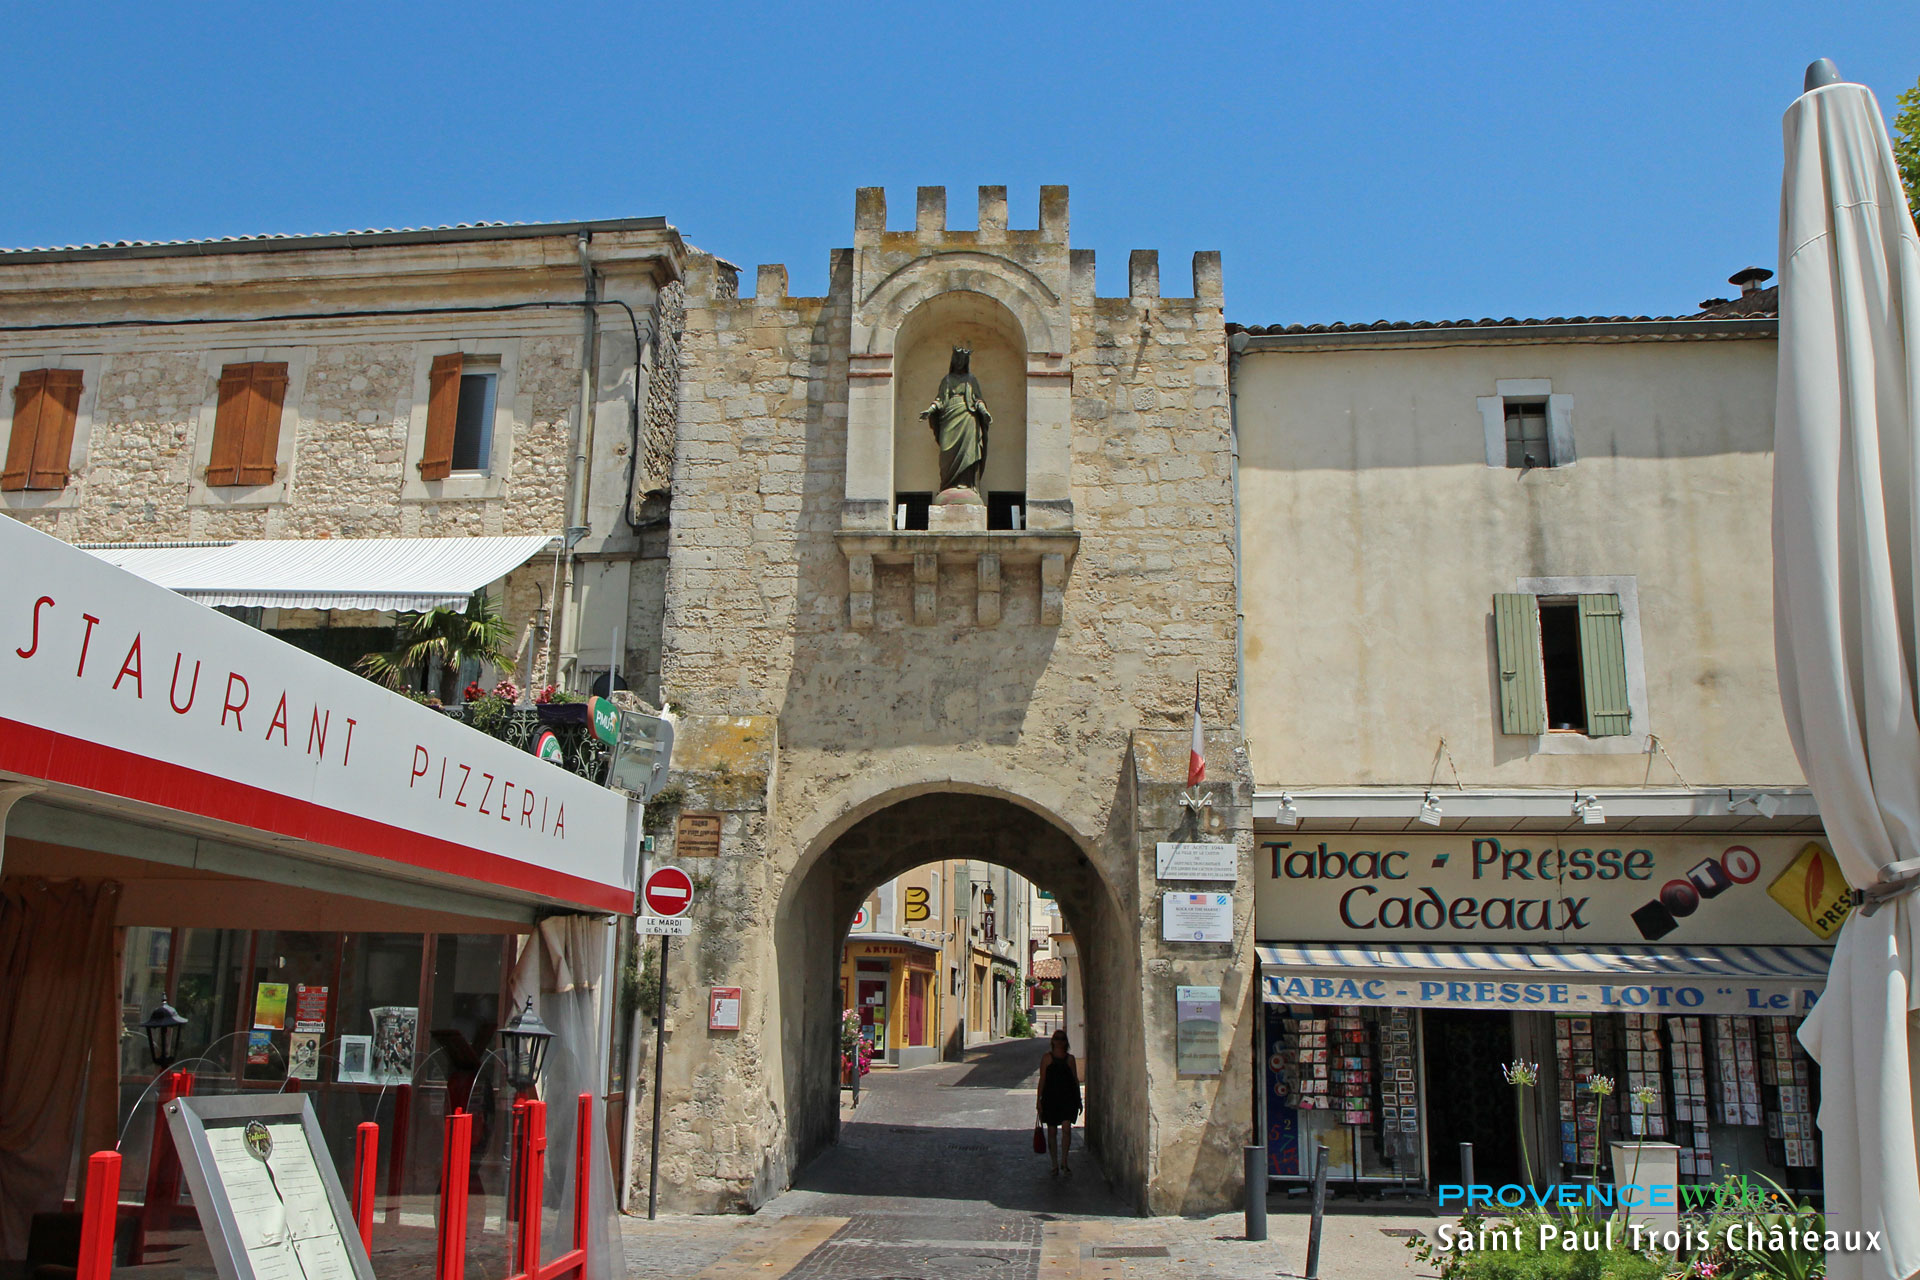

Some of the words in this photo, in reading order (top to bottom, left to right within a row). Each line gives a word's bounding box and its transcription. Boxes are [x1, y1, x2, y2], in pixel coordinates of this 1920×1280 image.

[595, 710, 612, 732] PMU
[410, 744, 565, 840] PIZZERIA
[1260, 840, 1410, 880] Tabac
[1471, 837, 1656, 881] Presse
[1338, 884, 1591, 931] Cadeaux
[1263, 975, 1386, 1000] TABAC
[1419, 981, 1569, 1004] PRESSE
[1599, 985, 1705, 1008] LOTO
[1746, 988, 1790, 1009] Le
